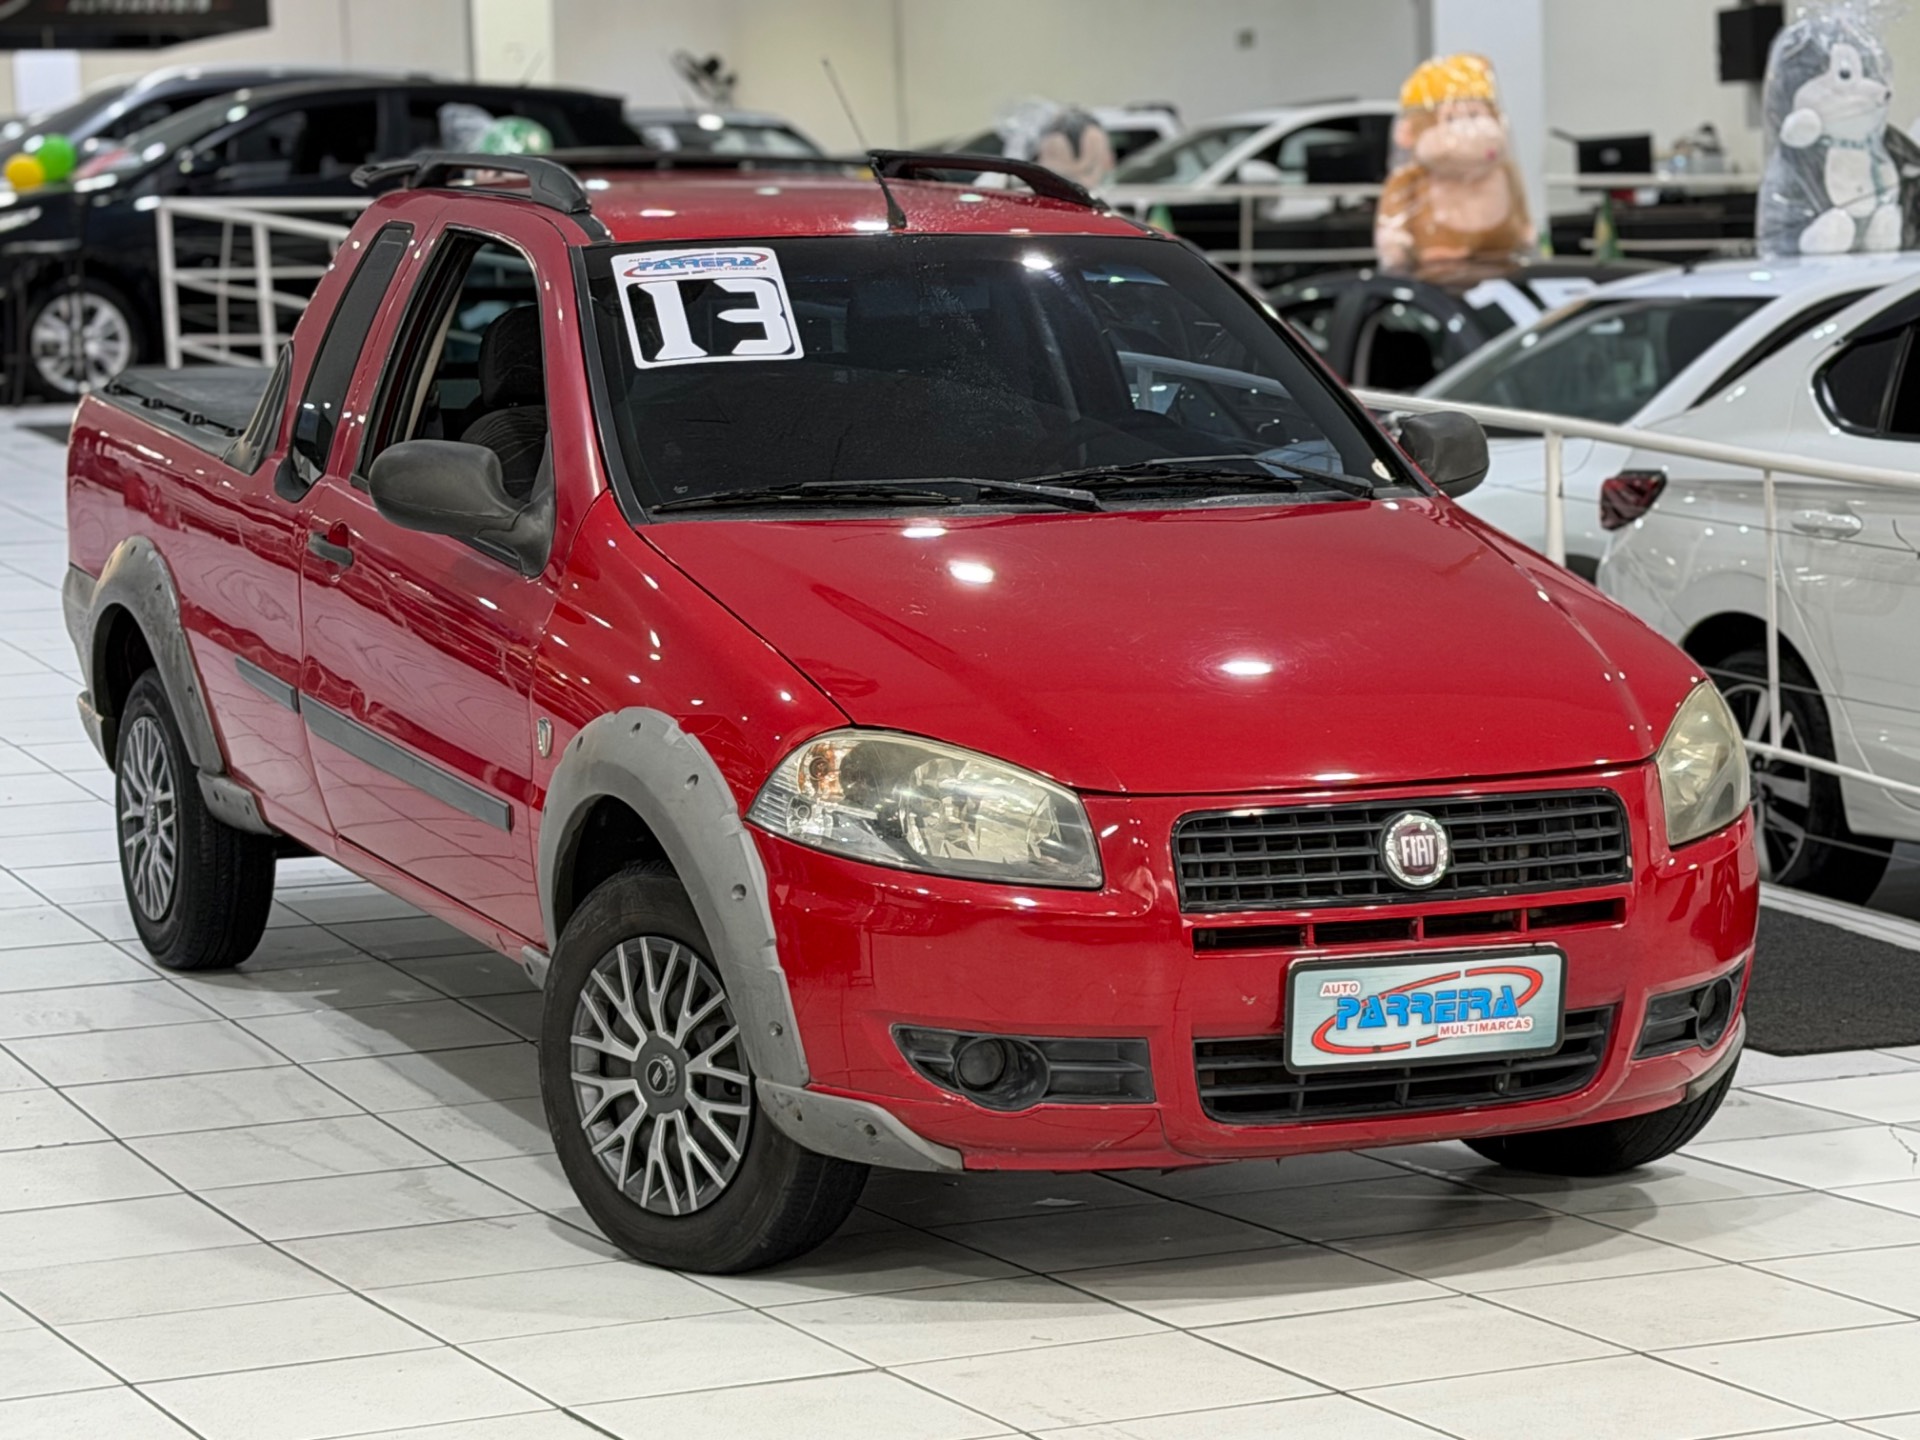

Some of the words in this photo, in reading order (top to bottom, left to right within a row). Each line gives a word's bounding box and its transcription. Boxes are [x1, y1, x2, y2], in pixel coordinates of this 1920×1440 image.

[637, 278, 792, 360] 13
[1400, 834, 1436, 867] FIAT
[1322, 983, 1359, 995] AUTO
[1335, 985, 1520, 1031] PARREIRA
[1439, 1018, 1532, 1035] MULTIMARCAS
